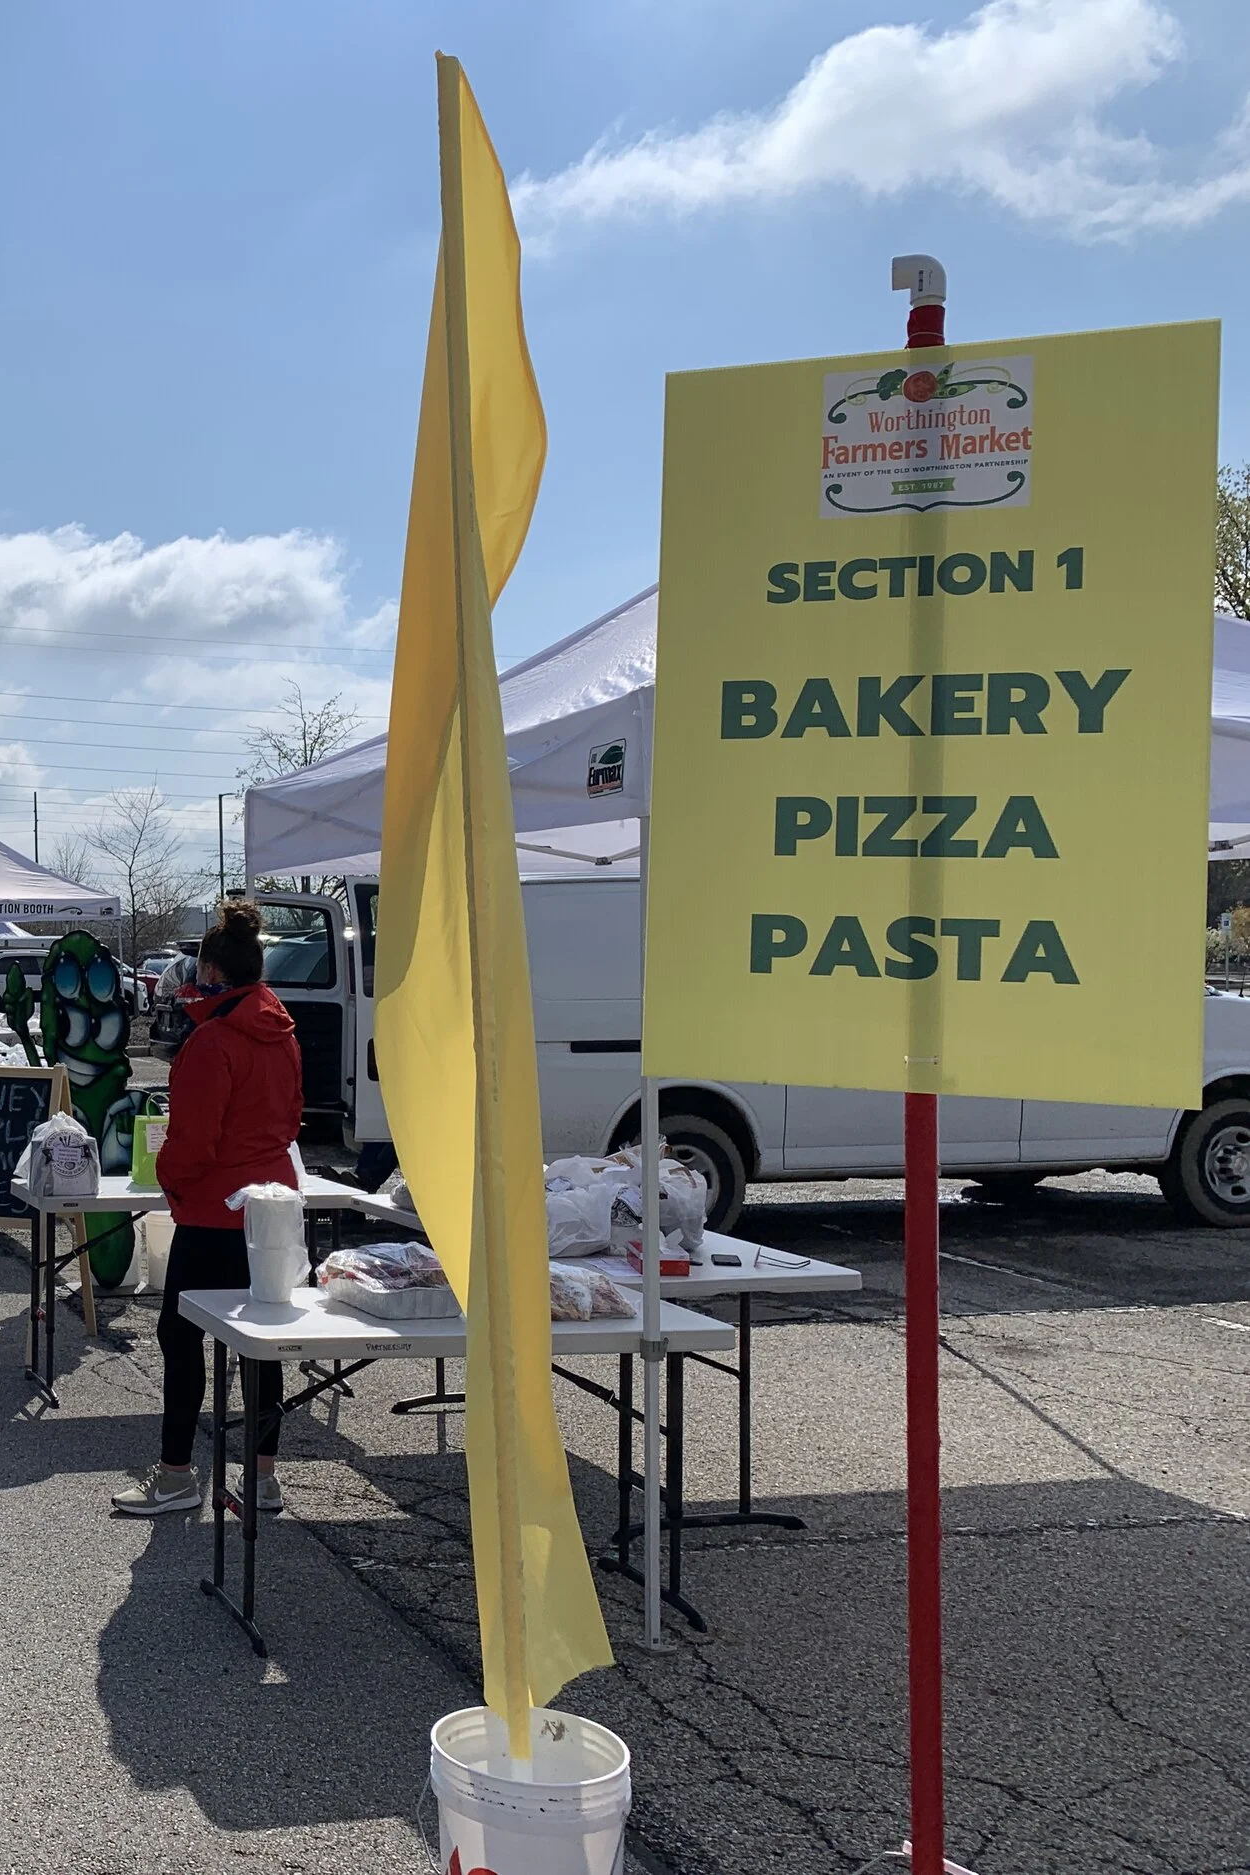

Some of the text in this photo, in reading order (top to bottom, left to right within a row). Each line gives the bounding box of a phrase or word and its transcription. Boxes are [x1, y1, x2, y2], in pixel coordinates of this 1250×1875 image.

[868, 405, 991, 433] Worthington
[821, 426, 1033, 470] Farmers Market
[912, 463, 972, 472] WORTHINGTON
[974, 458, 1029, 468] PARTNERSHIP
[766, 547, 1084, 604] SECTION 1
[720, 668, 1132, 740] BAKERY
[774, 795, 1060, 859] PIZZA
[23, 903, 54, 914] BOOTH
[749, 913, 1081, 985] PASTA
